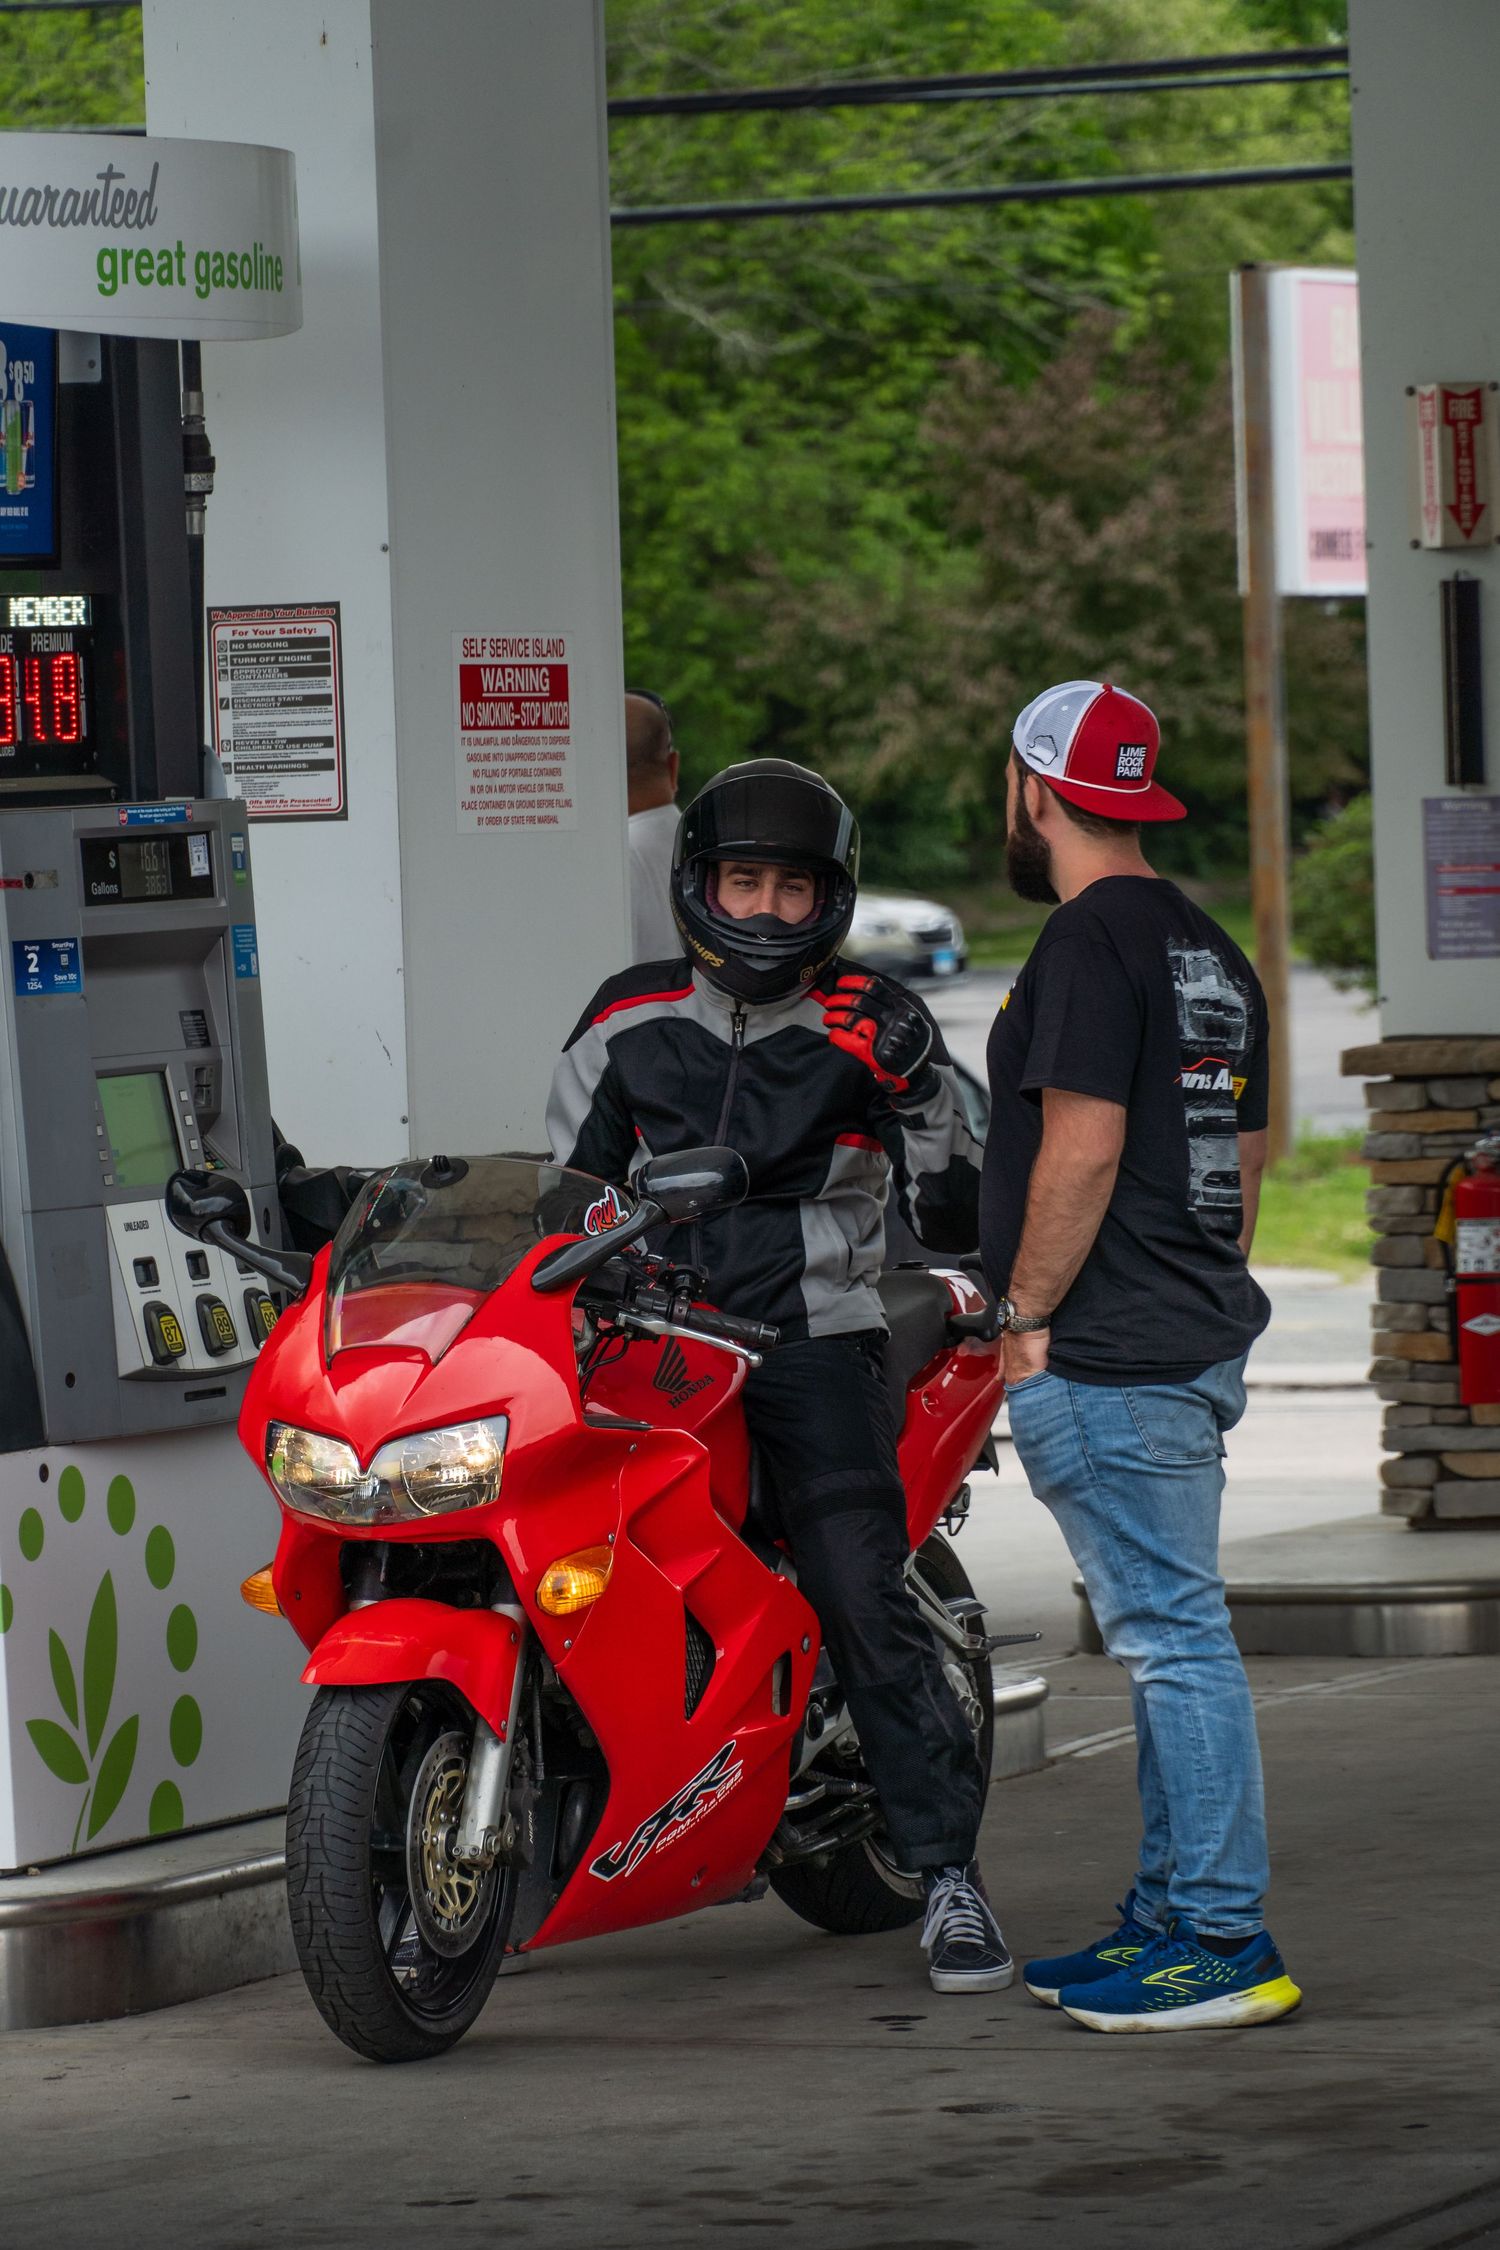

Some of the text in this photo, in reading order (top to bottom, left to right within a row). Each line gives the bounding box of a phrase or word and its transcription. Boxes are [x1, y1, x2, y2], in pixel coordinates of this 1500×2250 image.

[97, 240, 284, 299] great gasoline
[9, 596, 86, 627] MEMBER
[211, 607, 336, 620] We Appreciate Your Business
[231, 627, 317, 637] For Your Safety:
[31, 632, 73, 652] PREMIUM
[247, 641, 289, 649] SMOKING
[462, 638, 565, 658] SELF SERVICE ISLAND
[278, 654, 312, 662] ENGINE
[480, 667, 550, 692] WARNING
[462, 701, 475, 727] NO
[542, 701, 569, 726] MOTOR
[1120, 746, 1147, 757] LIME
[1118, 756, 1144, 767] ROCK
[1116, 766, 1143, 777] PARK
[108, 850, 117, 869] $
[91, 881, 119, 896] Gallons
[26, 952, 40, 974] 2
[54, 974, 67, 982] Save
[123, 1219, 150, 1232] UNLEADED
[215, 1316, 232, 1334] 89
[263, 1311, 277, 1329] 93
[164, 1325, 180, 1343] 87
[667, 1374, 715, 1409] HONDA
